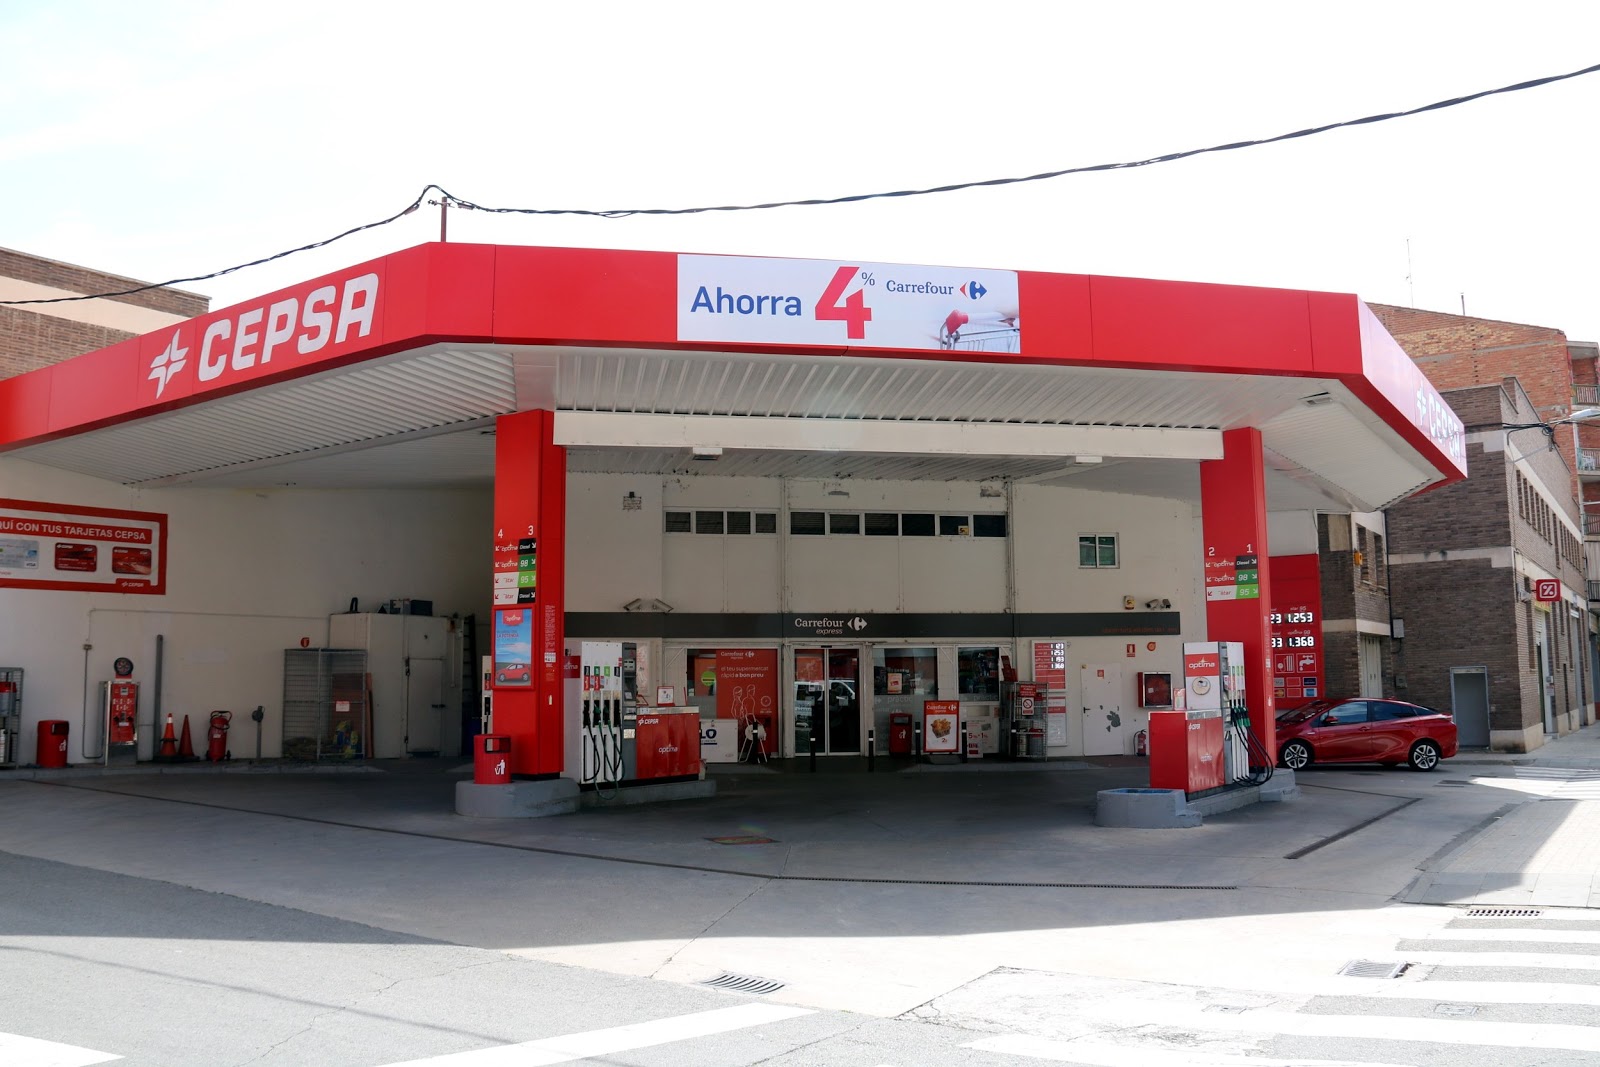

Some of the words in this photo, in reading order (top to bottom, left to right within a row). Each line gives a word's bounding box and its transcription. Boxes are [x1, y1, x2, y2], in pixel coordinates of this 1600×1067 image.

[886, 279, 954, 295] Carrefour
[690, 286, 802, 316] Ahorra
[198, 273, 379, 382] CEPSA
[16, 522, 39, 533] CON
[41, 524, 62, 534] TUS
[64, 526, 113, 538] TARJETAS
[115, 530, 146, 540] CEPSA
[498, 528, 504, 538] 4
[528, 525, 534, 536] 3
[1208, 546, 1215, 556] 2
[1246, 544, 1253, 553] 1
[1214, 560, 1234, 568] optima
[1214, 574, 1234, 582] optima
[794, 617, 844, 628] Carrefour
[1288, 612, 1313, 623] 1.253
[1289, 636, 1315, 647] 1.368
[1188, 660, 1215, 670] optima
[658, 746, 678, 754] optima
